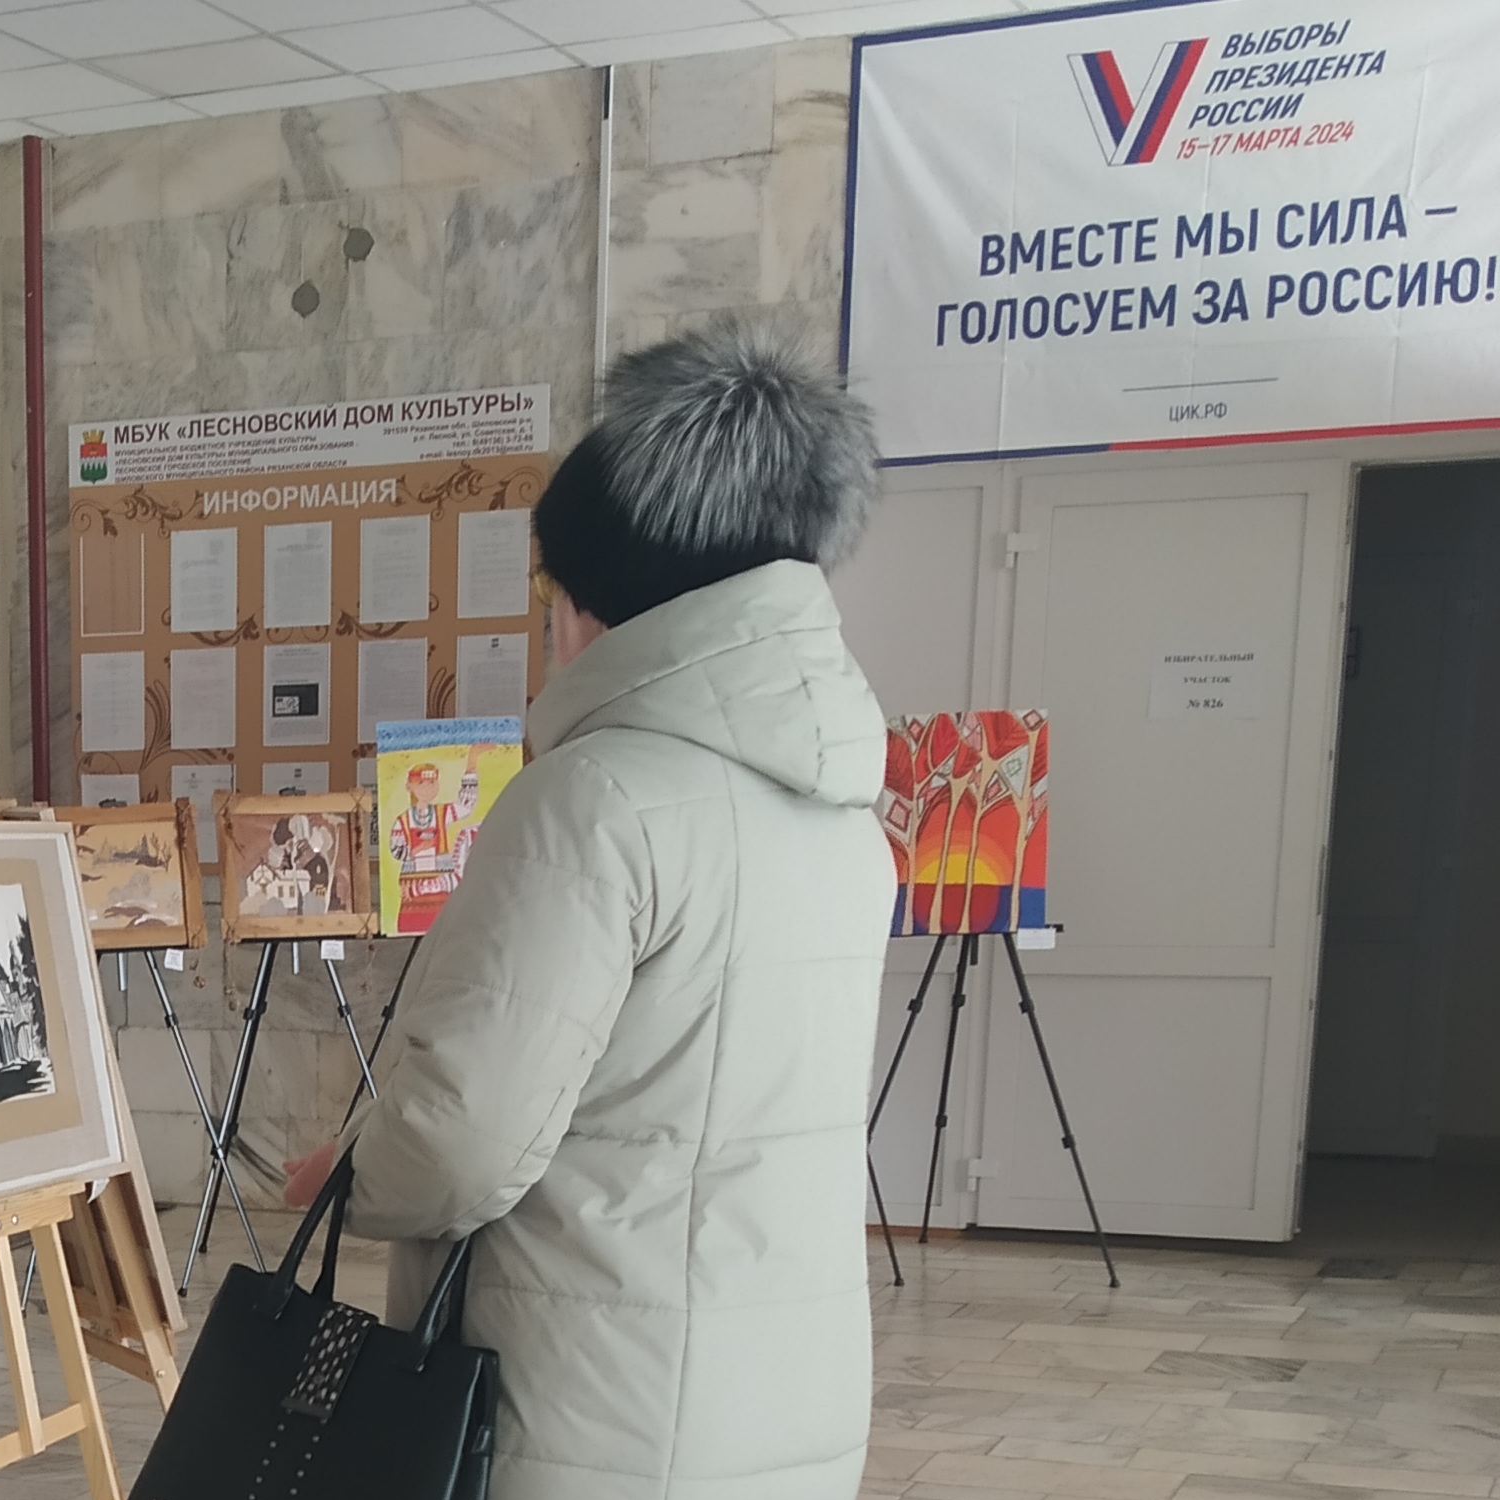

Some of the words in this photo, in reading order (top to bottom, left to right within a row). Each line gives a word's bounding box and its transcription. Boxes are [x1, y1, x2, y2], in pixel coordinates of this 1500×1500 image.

[1220, 19, 1351, 59] ВЫБОРЫ
[1204, 50, 1386, 94] ПРЕЗИДЕНТА
[1188, 93, 1304, 129] РОССИИ
[1232, 126, 1302, 154] МАРТА
[1303, 120, 1355, 146] 2024
[980, 217, 1159, 277] ВМЕСТЕ
[1175, 208, 1259, 258] МЫ
[1276, 194, 1407, 249] СИЛА
[936, 284, 1177, 347] ГОЛОСУЕМ
[1192, 278, 1249, 325] ЗА
[1266, 255, 1497, 319] РОССИЮ!
[114, 422, 170, 445] МБУК
[177, 402, 337, 439] «ЛЕСНОВСКИЙ
[343, 403, 393, 429] ДОМ
[401, 392, 534, 422] КУЛЬТУРЫ»
[1168, 402, 1228, 422] ЦИК.РФ
[202, 478, 399, 516] ИНФОРМАЦИЯ
